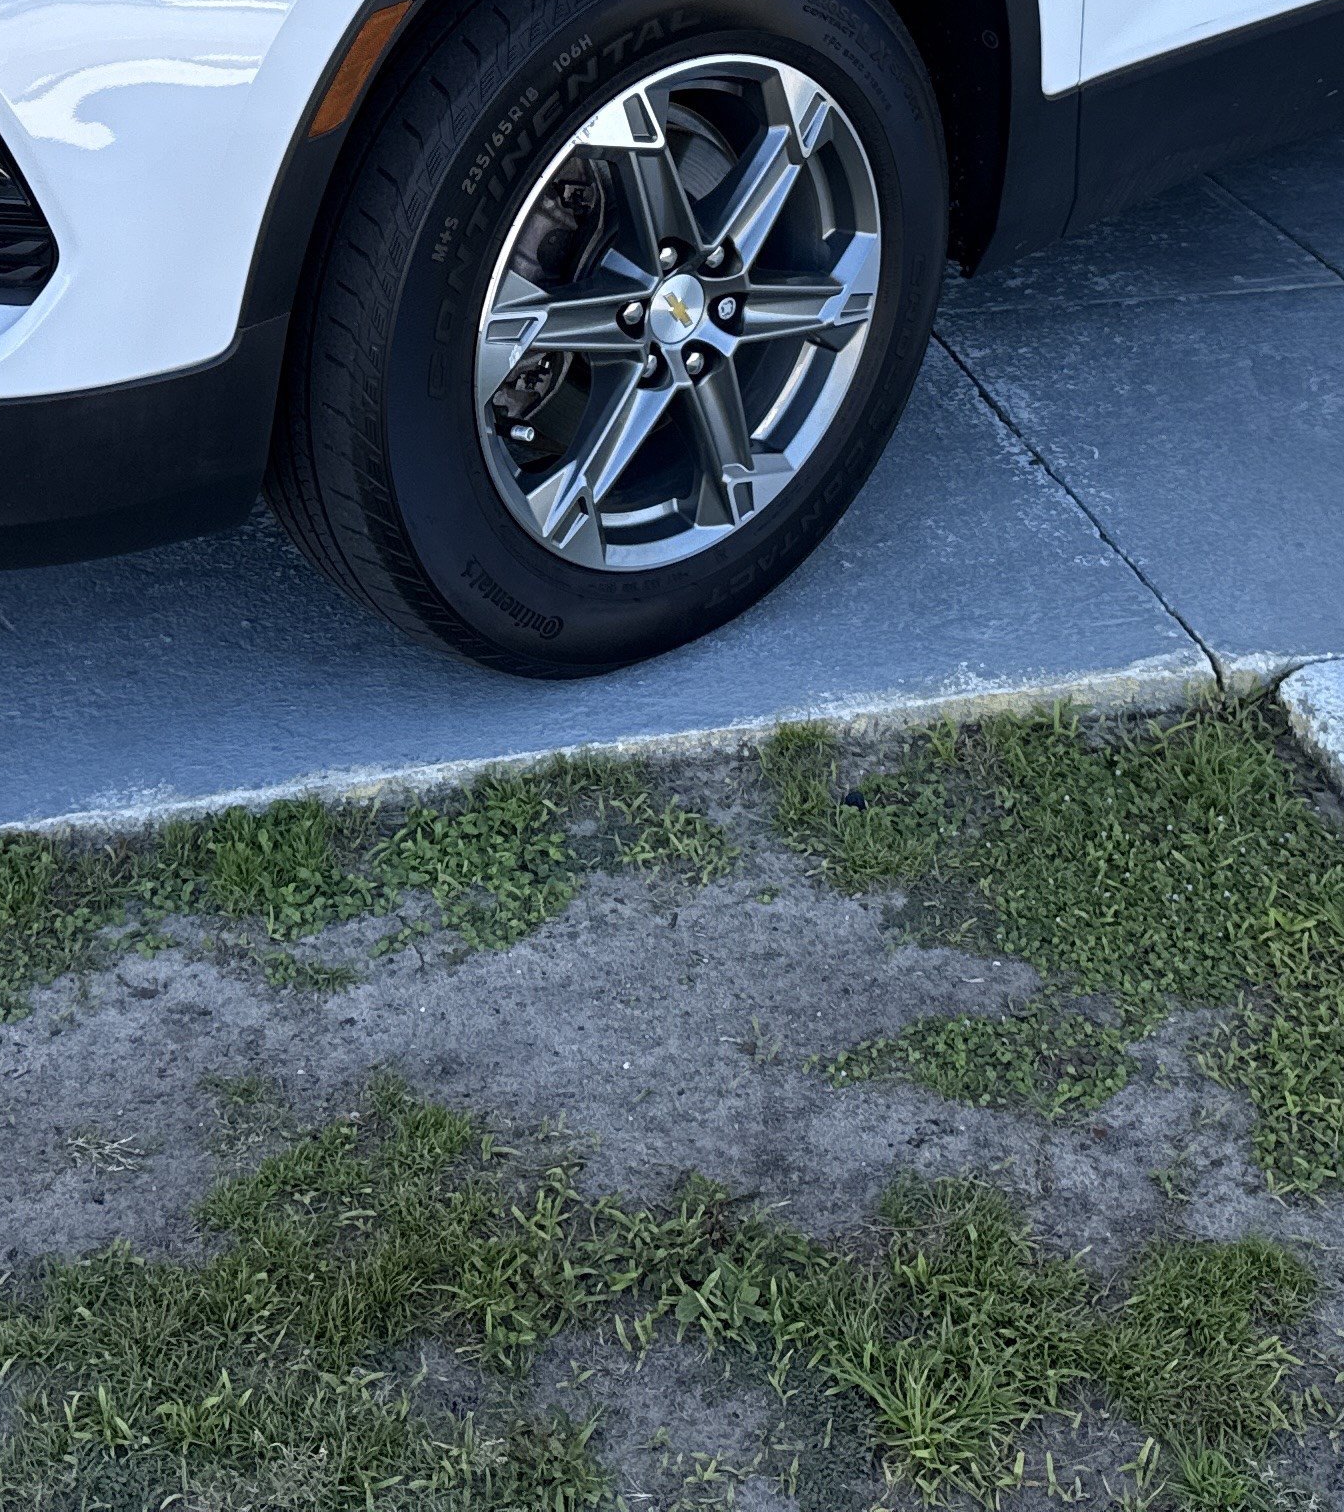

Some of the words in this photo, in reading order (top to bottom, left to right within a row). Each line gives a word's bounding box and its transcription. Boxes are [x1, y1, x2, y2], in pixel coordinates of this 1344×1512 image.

[427, 9, 701, 402] CONTINENTAL
[432, 216, 459, 264] M+S
[552, 34, 593, 73] 106H
